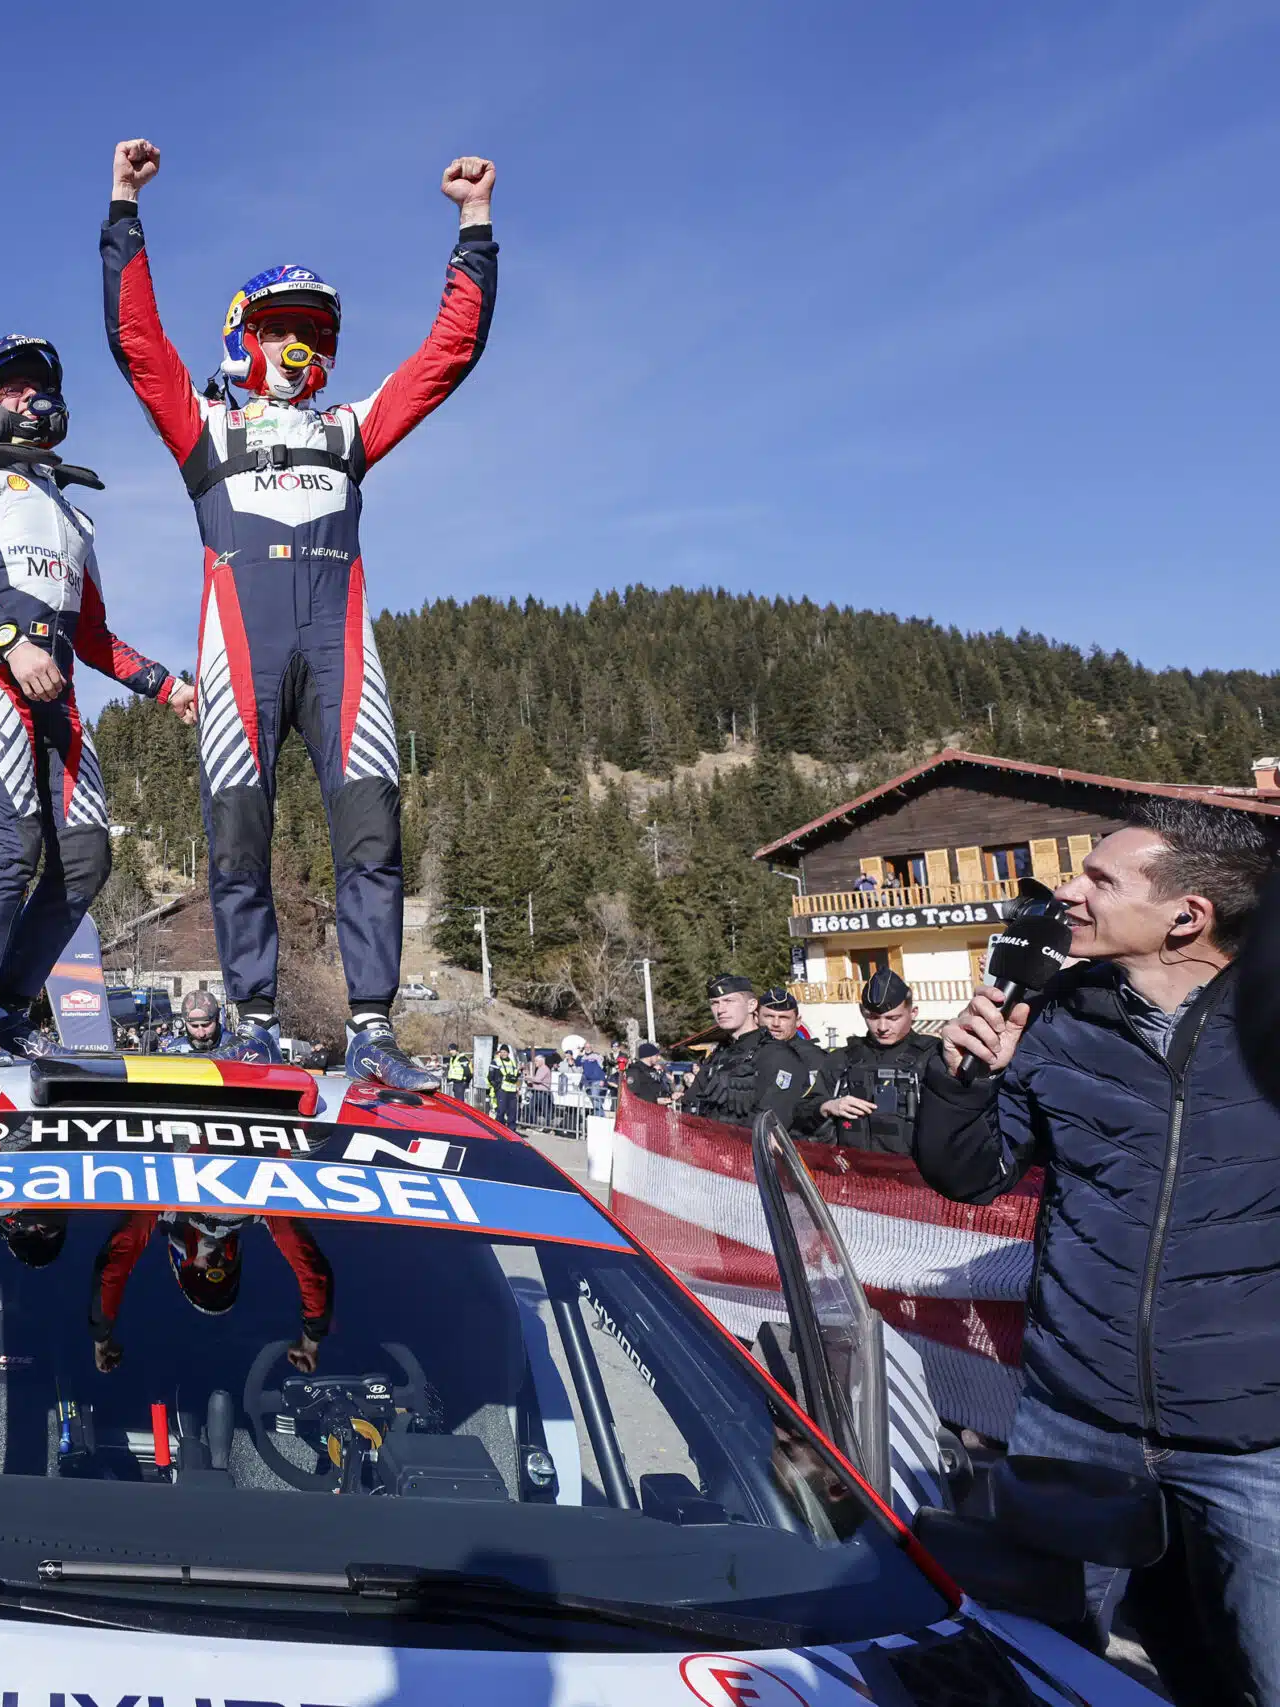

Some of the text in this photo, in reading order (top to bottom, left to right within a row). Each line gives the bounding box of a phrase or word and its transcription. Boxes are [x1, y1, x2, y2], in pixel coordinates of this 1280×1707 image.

[288, 283, 324, 291] HYUNDAI
[254, 473, 333, 492] MOBIS
[311, 546, 349, 560] NEUVILLE
[811, 913, 870, 933] Hôtel
[877, 909, 917, 929] des
[922, 904, 988, 926] Trois
[31, 1119, 310, 1152] HYUNDAI
